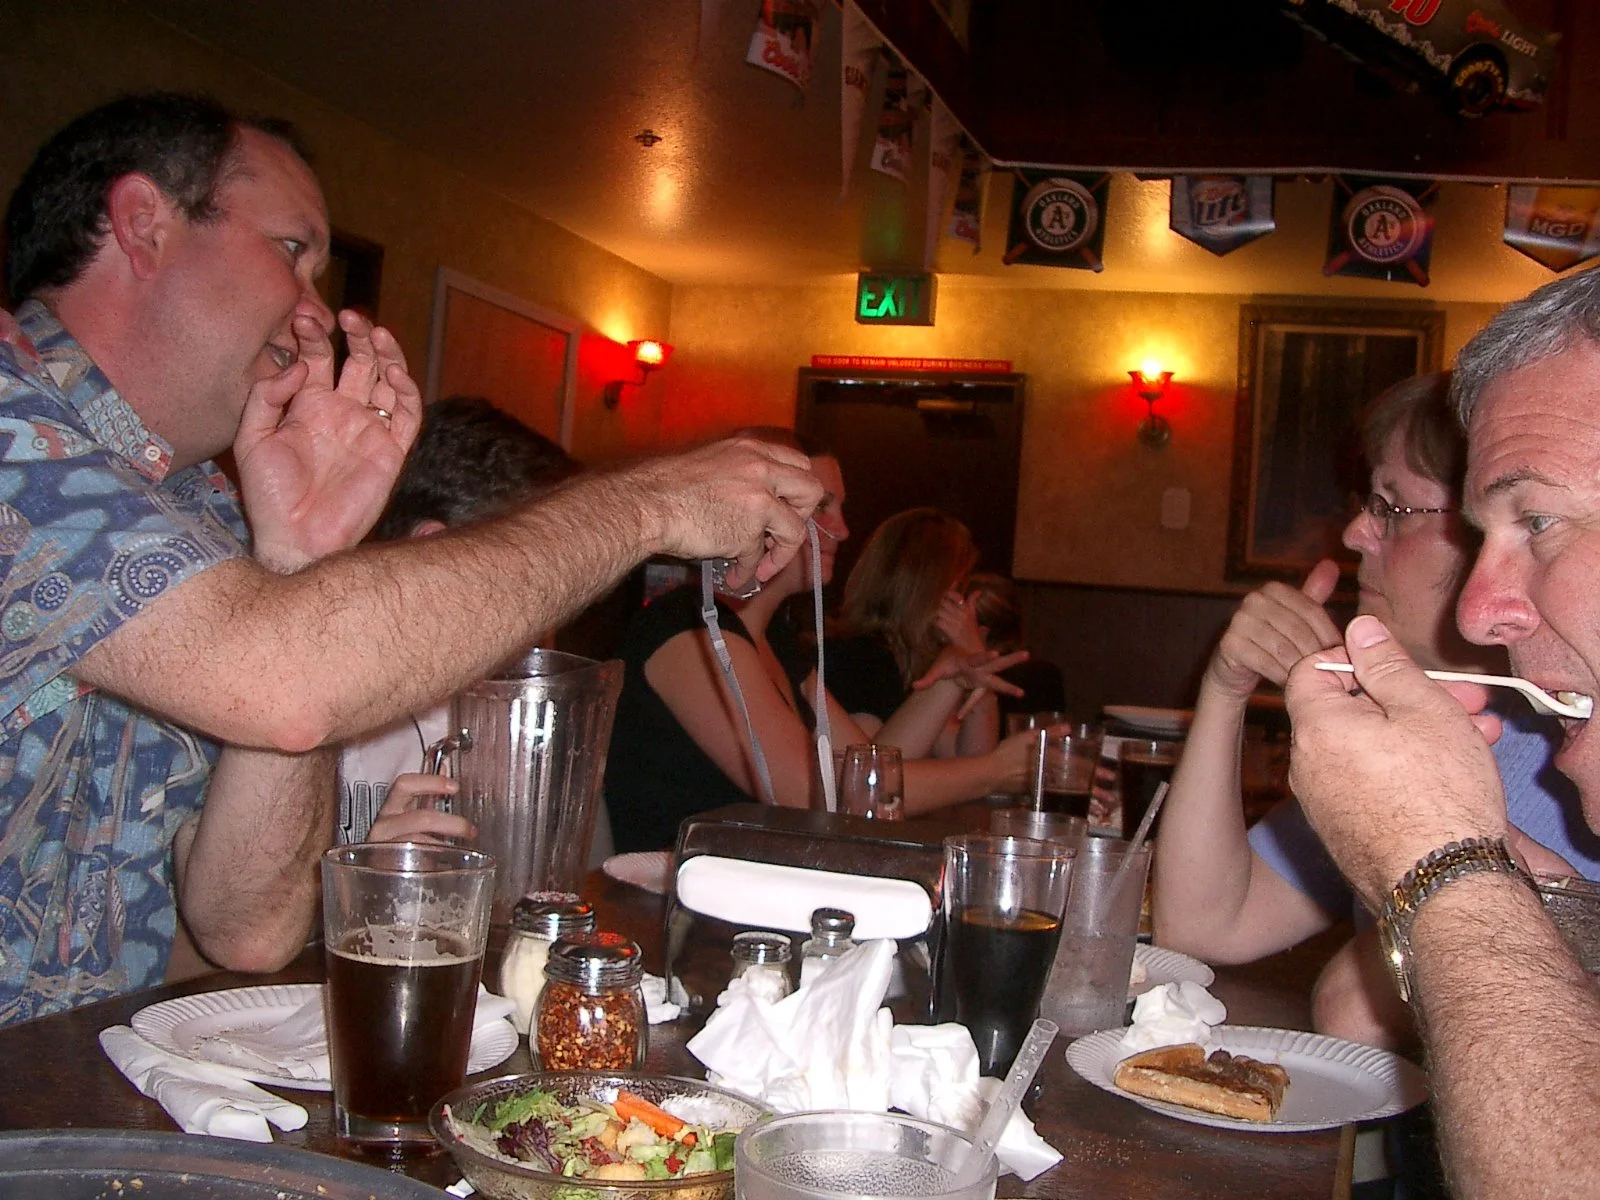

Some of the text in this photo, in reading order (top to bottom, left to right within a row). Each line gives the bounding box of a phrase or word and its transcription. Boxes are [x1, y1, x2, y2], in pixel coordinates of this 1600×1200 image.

[1501, 30, 1538, 57] LIGHT
[1039, 192, 1081, 209] OAKLAND
[1361, 201, 1407, 219] OAKLAND
[1531, 217, 1586, 238] MGD
[860, 280, 924, 318] EXIT
